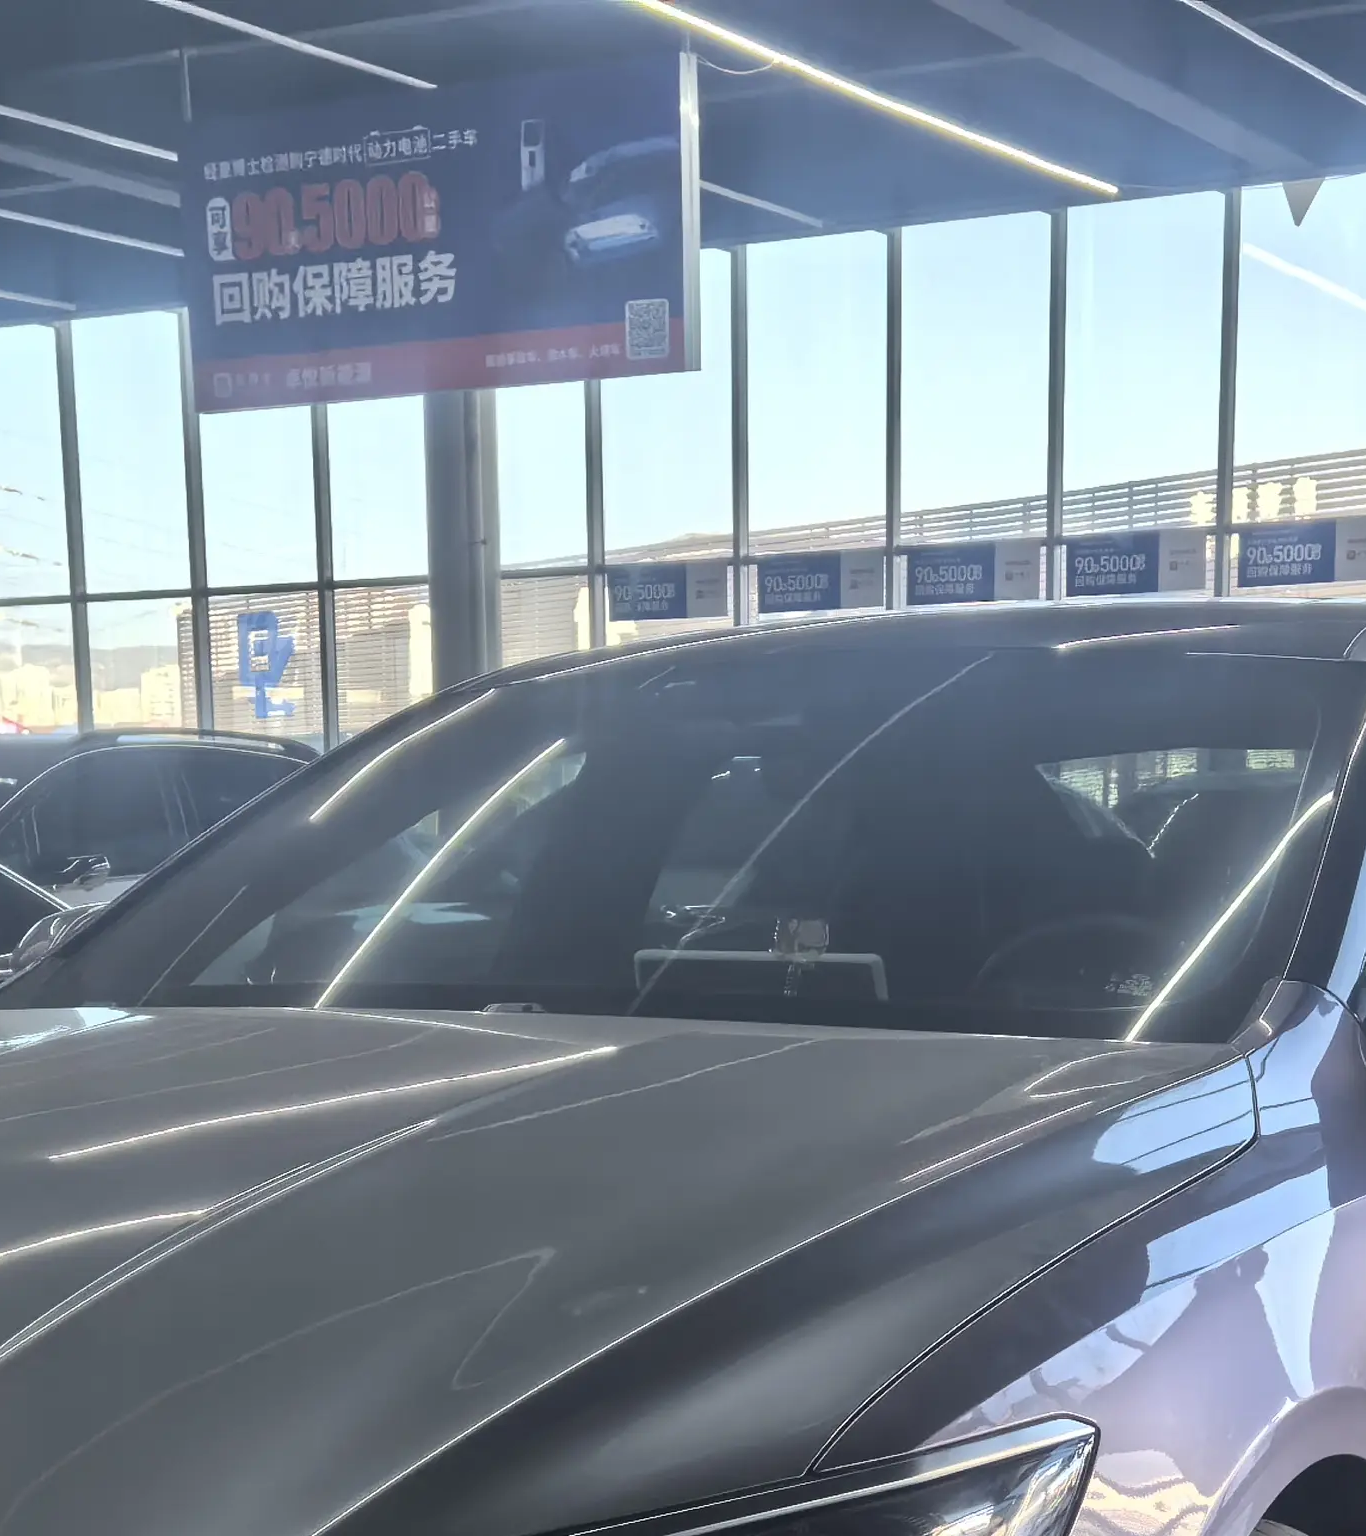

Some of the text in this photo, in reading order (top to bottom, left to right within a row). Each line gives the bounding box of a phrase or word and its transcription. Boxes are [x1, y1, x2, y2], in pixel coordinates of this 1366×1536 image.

[213, 250, 457, 326] 回购保障服务
